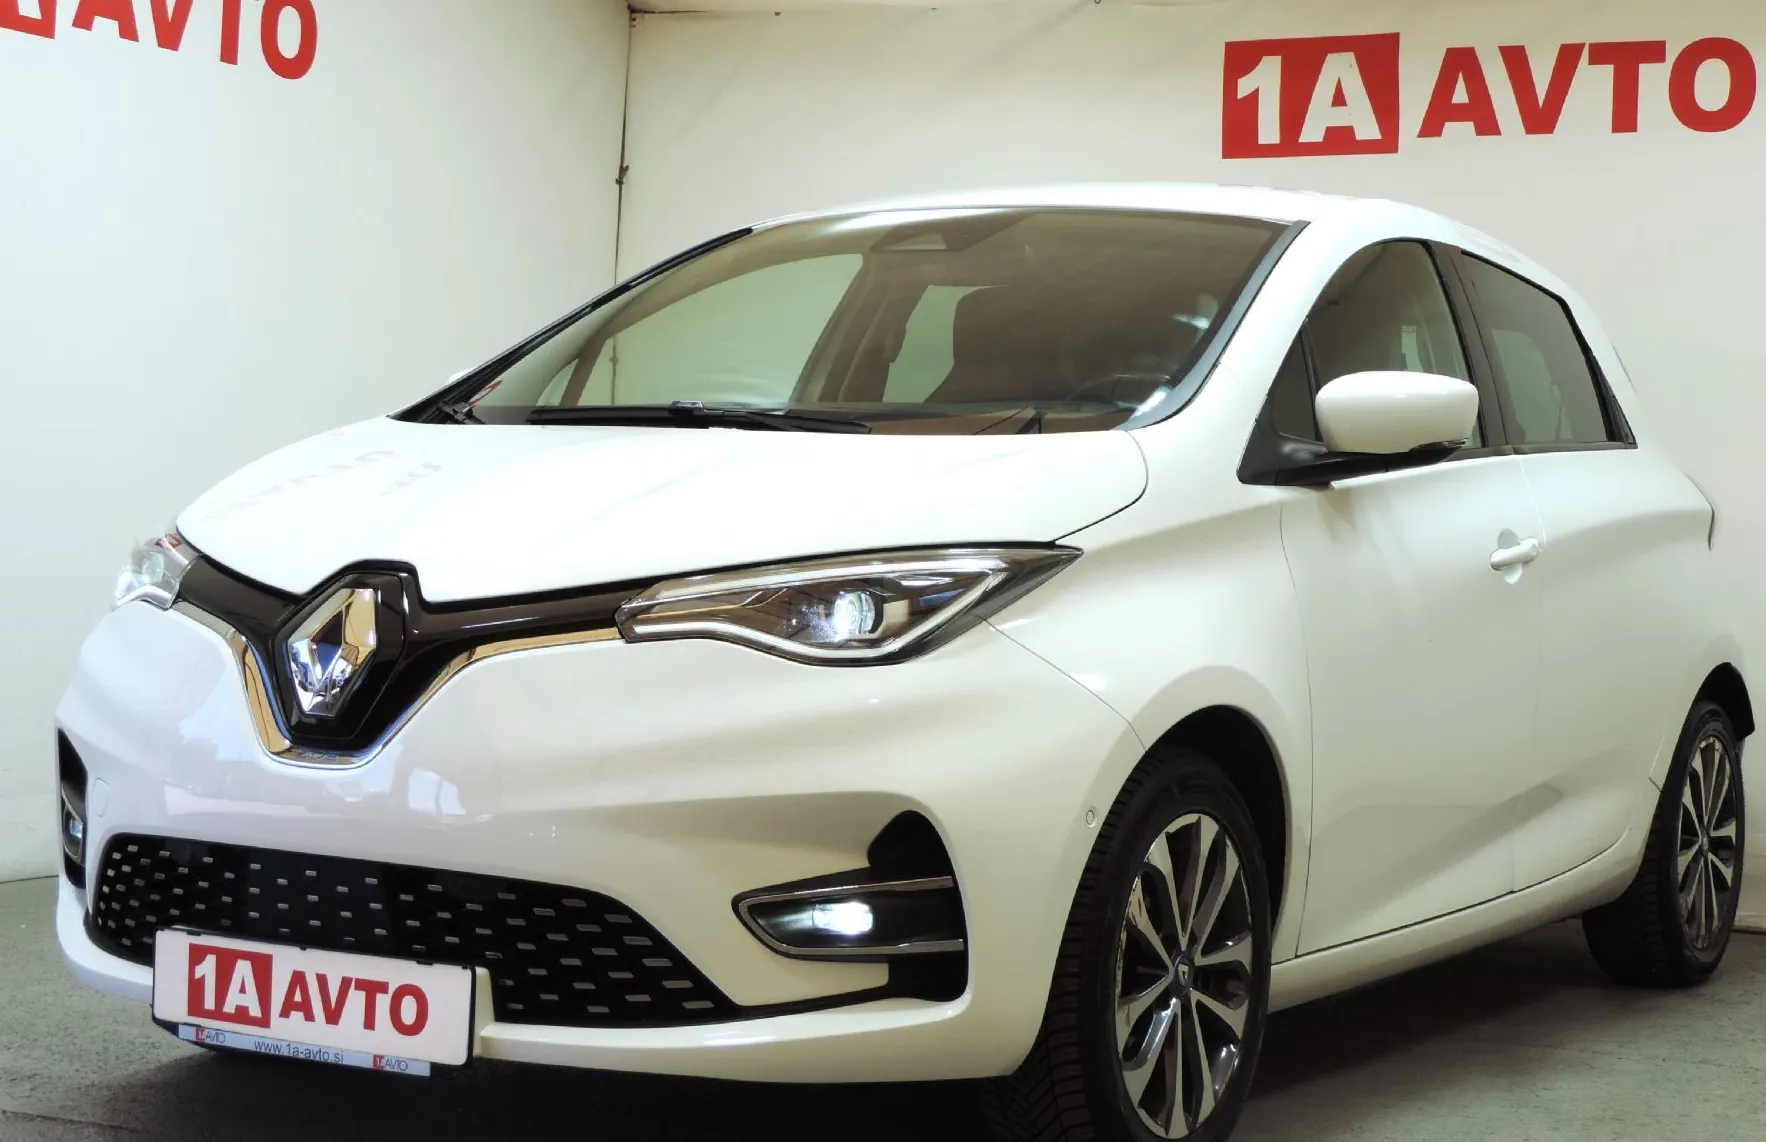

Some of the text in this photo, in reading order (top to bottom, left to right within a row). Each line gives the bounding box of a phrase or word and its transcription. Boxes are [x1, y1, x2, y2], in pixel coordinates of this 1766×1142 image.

[1237, 37, 1756, 144] 1A AVTO
[195, 954, 428, 1036] 1A AVTO
[254, 1040, 344, 1063] www.1a-avto.si
